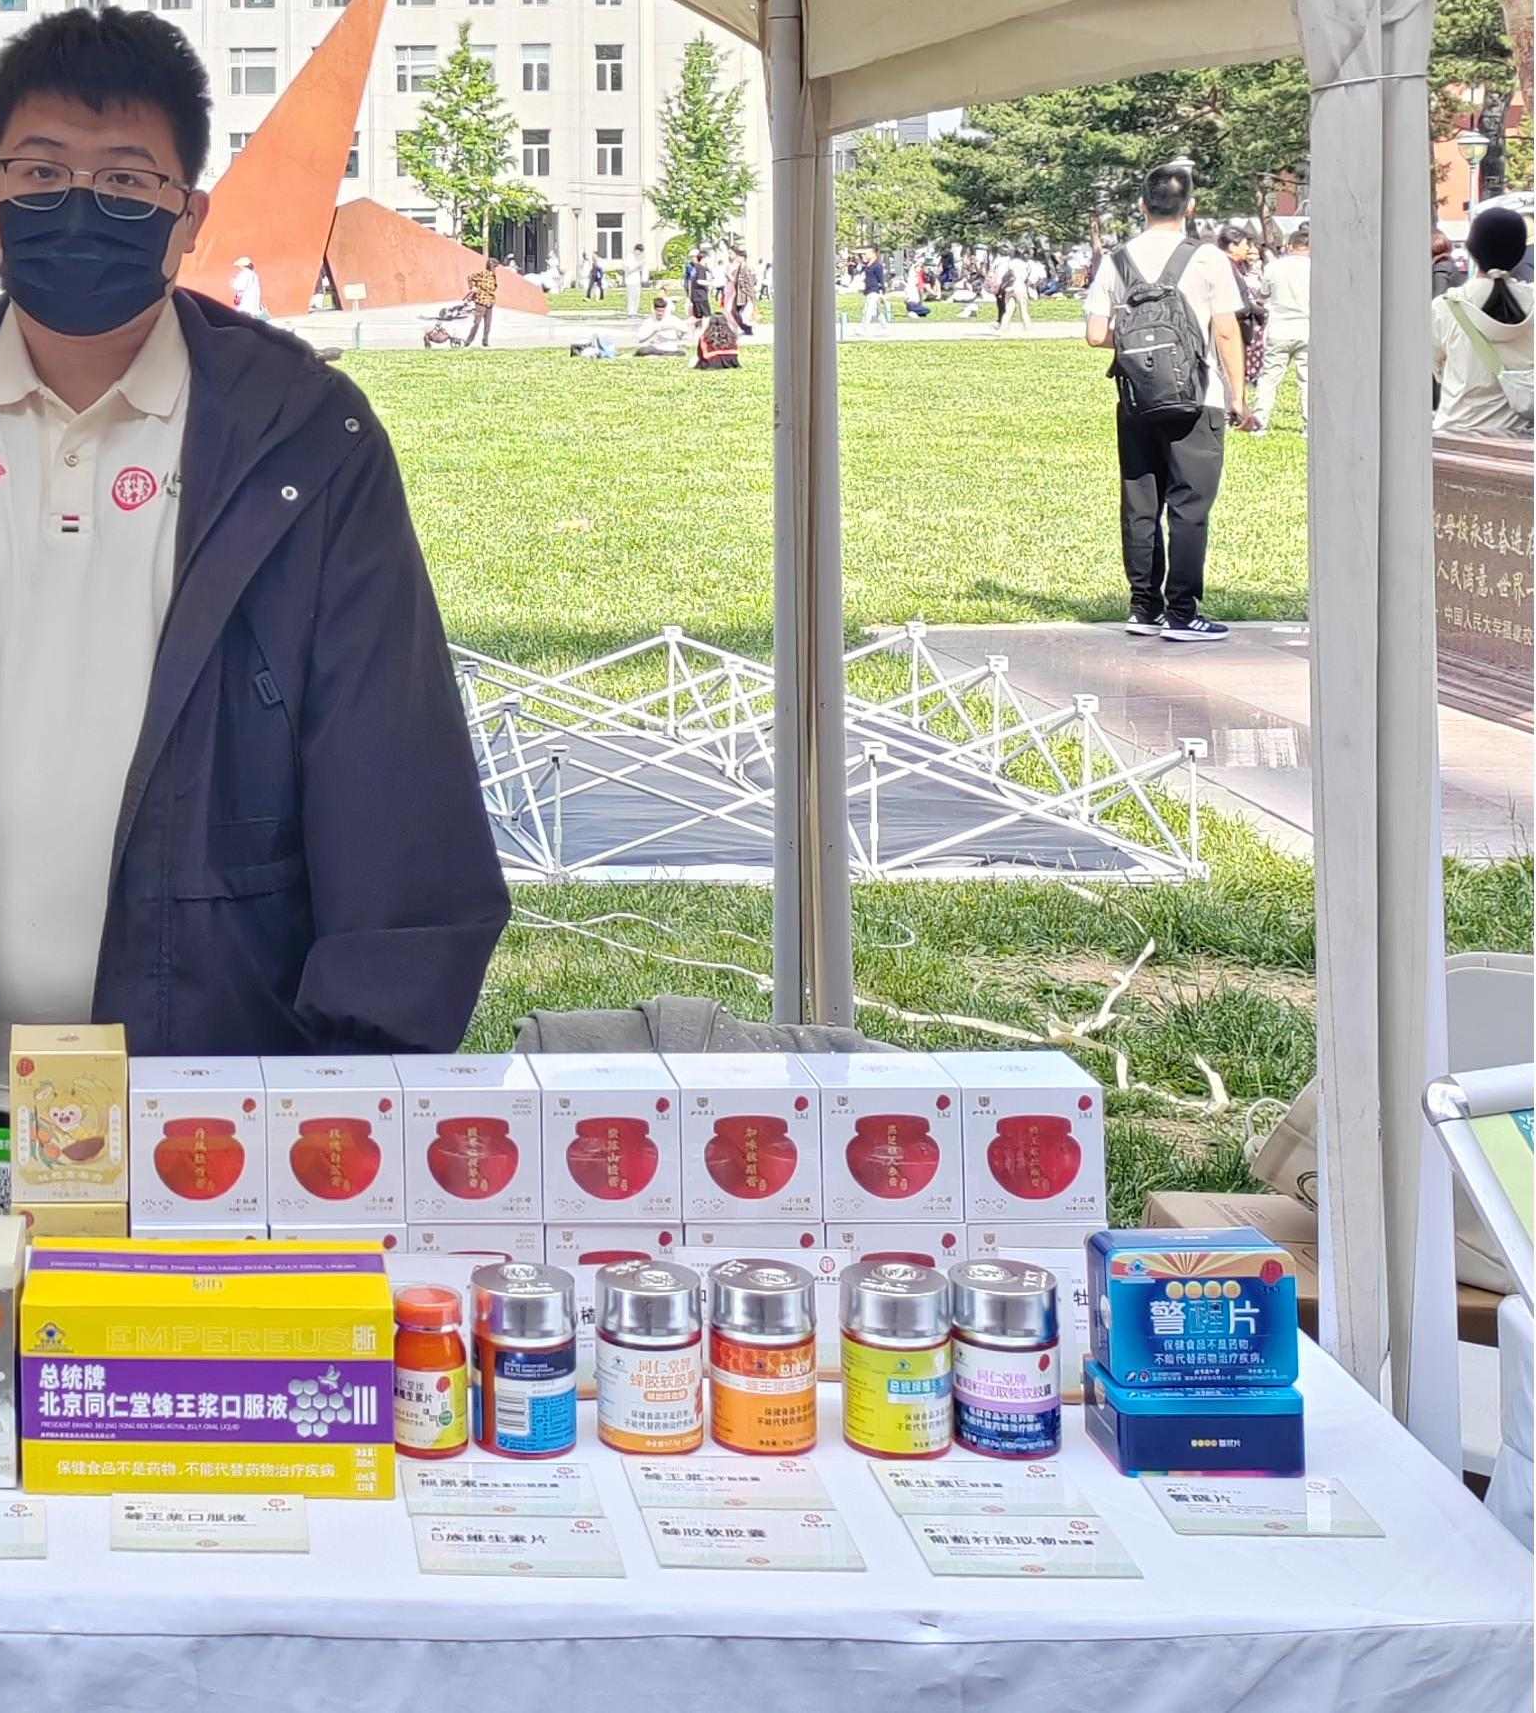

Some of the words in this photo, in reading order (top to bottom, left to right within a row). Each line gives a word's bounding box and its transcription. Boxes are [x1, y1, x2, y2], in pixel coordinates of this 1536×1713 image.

[106, 1324, 351, 1352] EMPEREUS
[39, 1363, 106, 1390] 总统牌
[39, 1392, 288, 1420] 北京同仁堂蜂王浆口服液
[125, 1512, 246, 1522] 蜂王浆口服液
[662, 1527, 767, 1538] 蜂胶软胶囊
